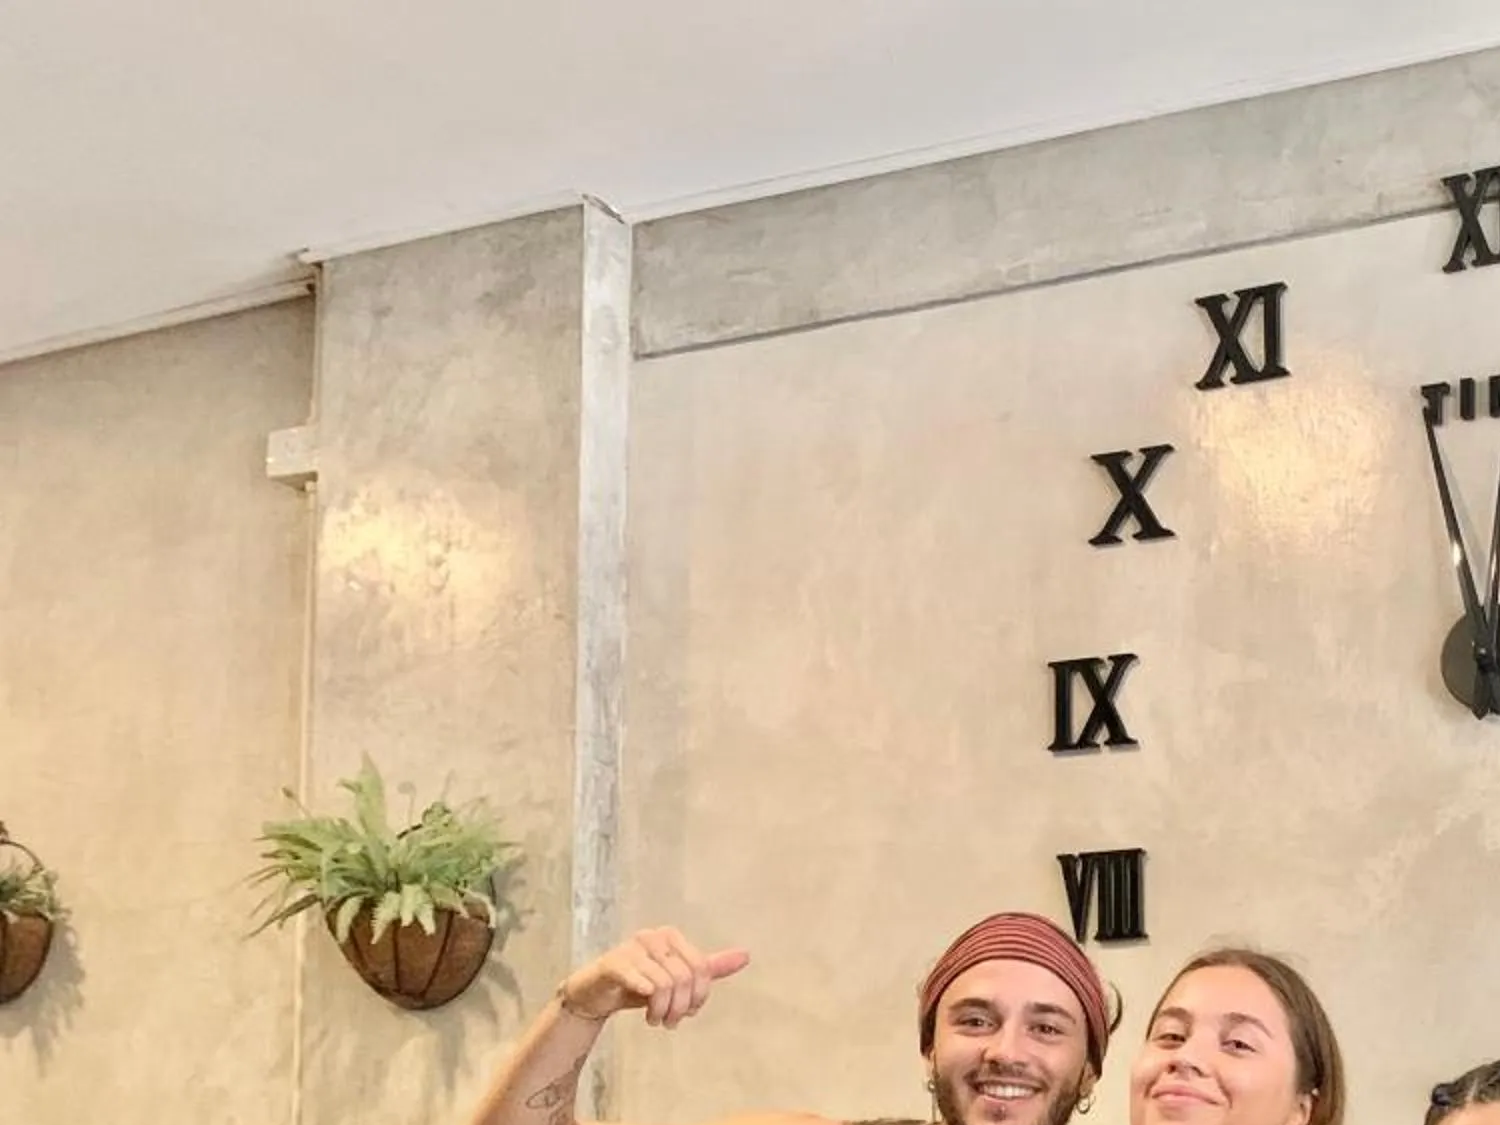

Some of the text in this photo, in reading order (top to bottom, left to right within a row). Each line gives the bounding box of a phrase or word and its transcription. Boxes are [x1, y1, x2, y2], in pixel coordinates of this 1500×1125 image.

[1194, 282, 1290, 391] XI
[1088, 444, 1176, 547] X
[1047, 653, 1138, 753] IX
[1056, 847, 1149, 945] VIII
